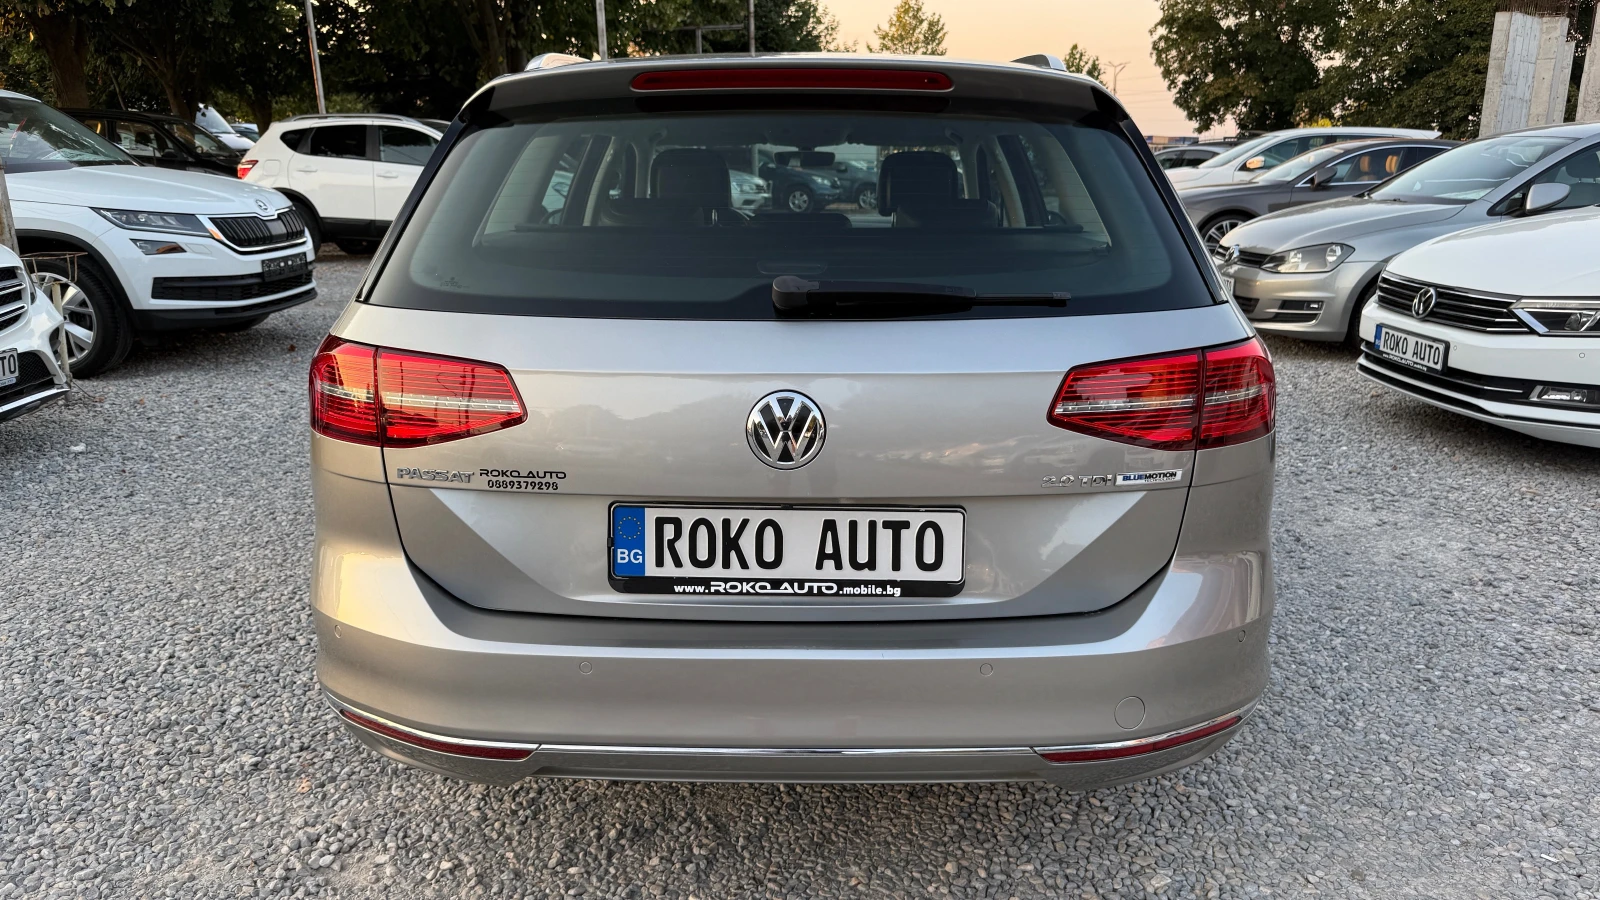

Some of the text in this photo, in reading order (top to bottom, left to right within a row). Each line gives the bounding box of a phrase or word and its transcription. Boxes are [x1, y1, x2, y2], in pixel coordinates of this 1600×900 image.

[1383, 331, 1441, 365] ROKO AUTO
[396, 467, 475, 484] PASSAT
[1041, 474, 1075, 487] 2.0
[1078, 474, 1113, 487] TDI
[487, 480, 559, 490] 0889379298
[654, 516, 944, 572] ROKO AUTO
[616, 549, 643, 564] BG
